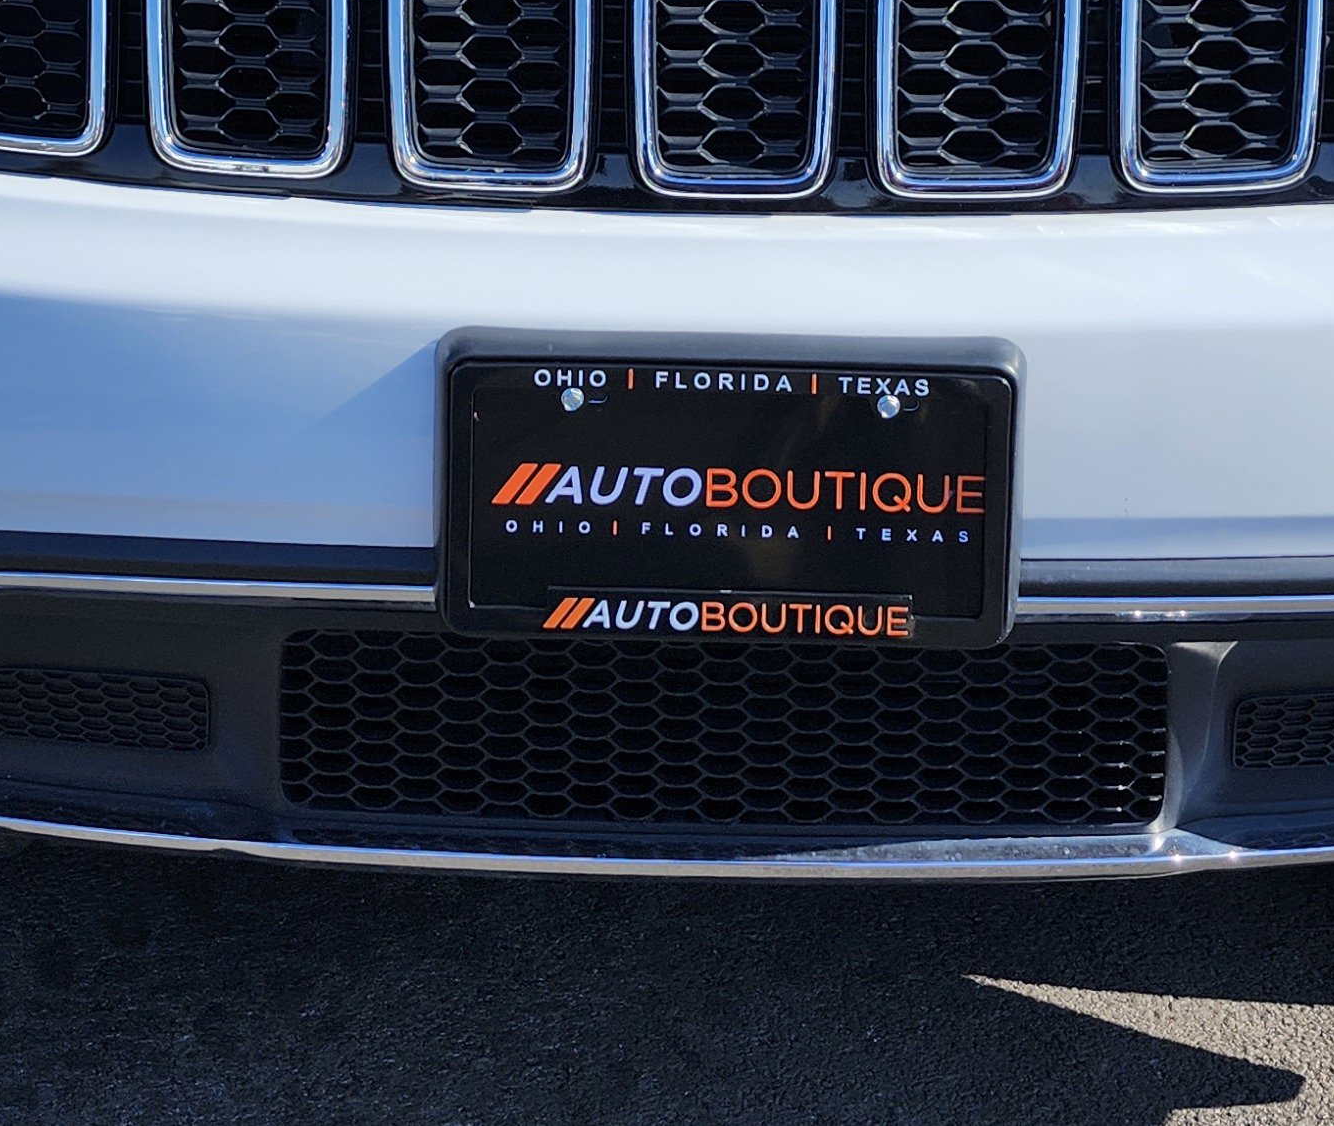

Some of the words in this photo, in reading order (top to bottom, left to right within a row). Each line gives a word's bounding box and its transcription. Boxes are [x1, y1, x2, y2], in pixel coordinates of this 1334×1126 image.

[533, 368, 607, 388] OHIO
[654, 370, 793, 393] FLORIDA
[838, 376, 930, 397] TEXAS
[544, 465, 987, 515] AUTOBOUTIQUE
[505, 520, 591, 533] OHIO
[641, 522, 800, 538] FLORIDA
[856, 528, 970, 543] TEXAS
[582, 600, 910, 636] AUTOBOUTIQUE
